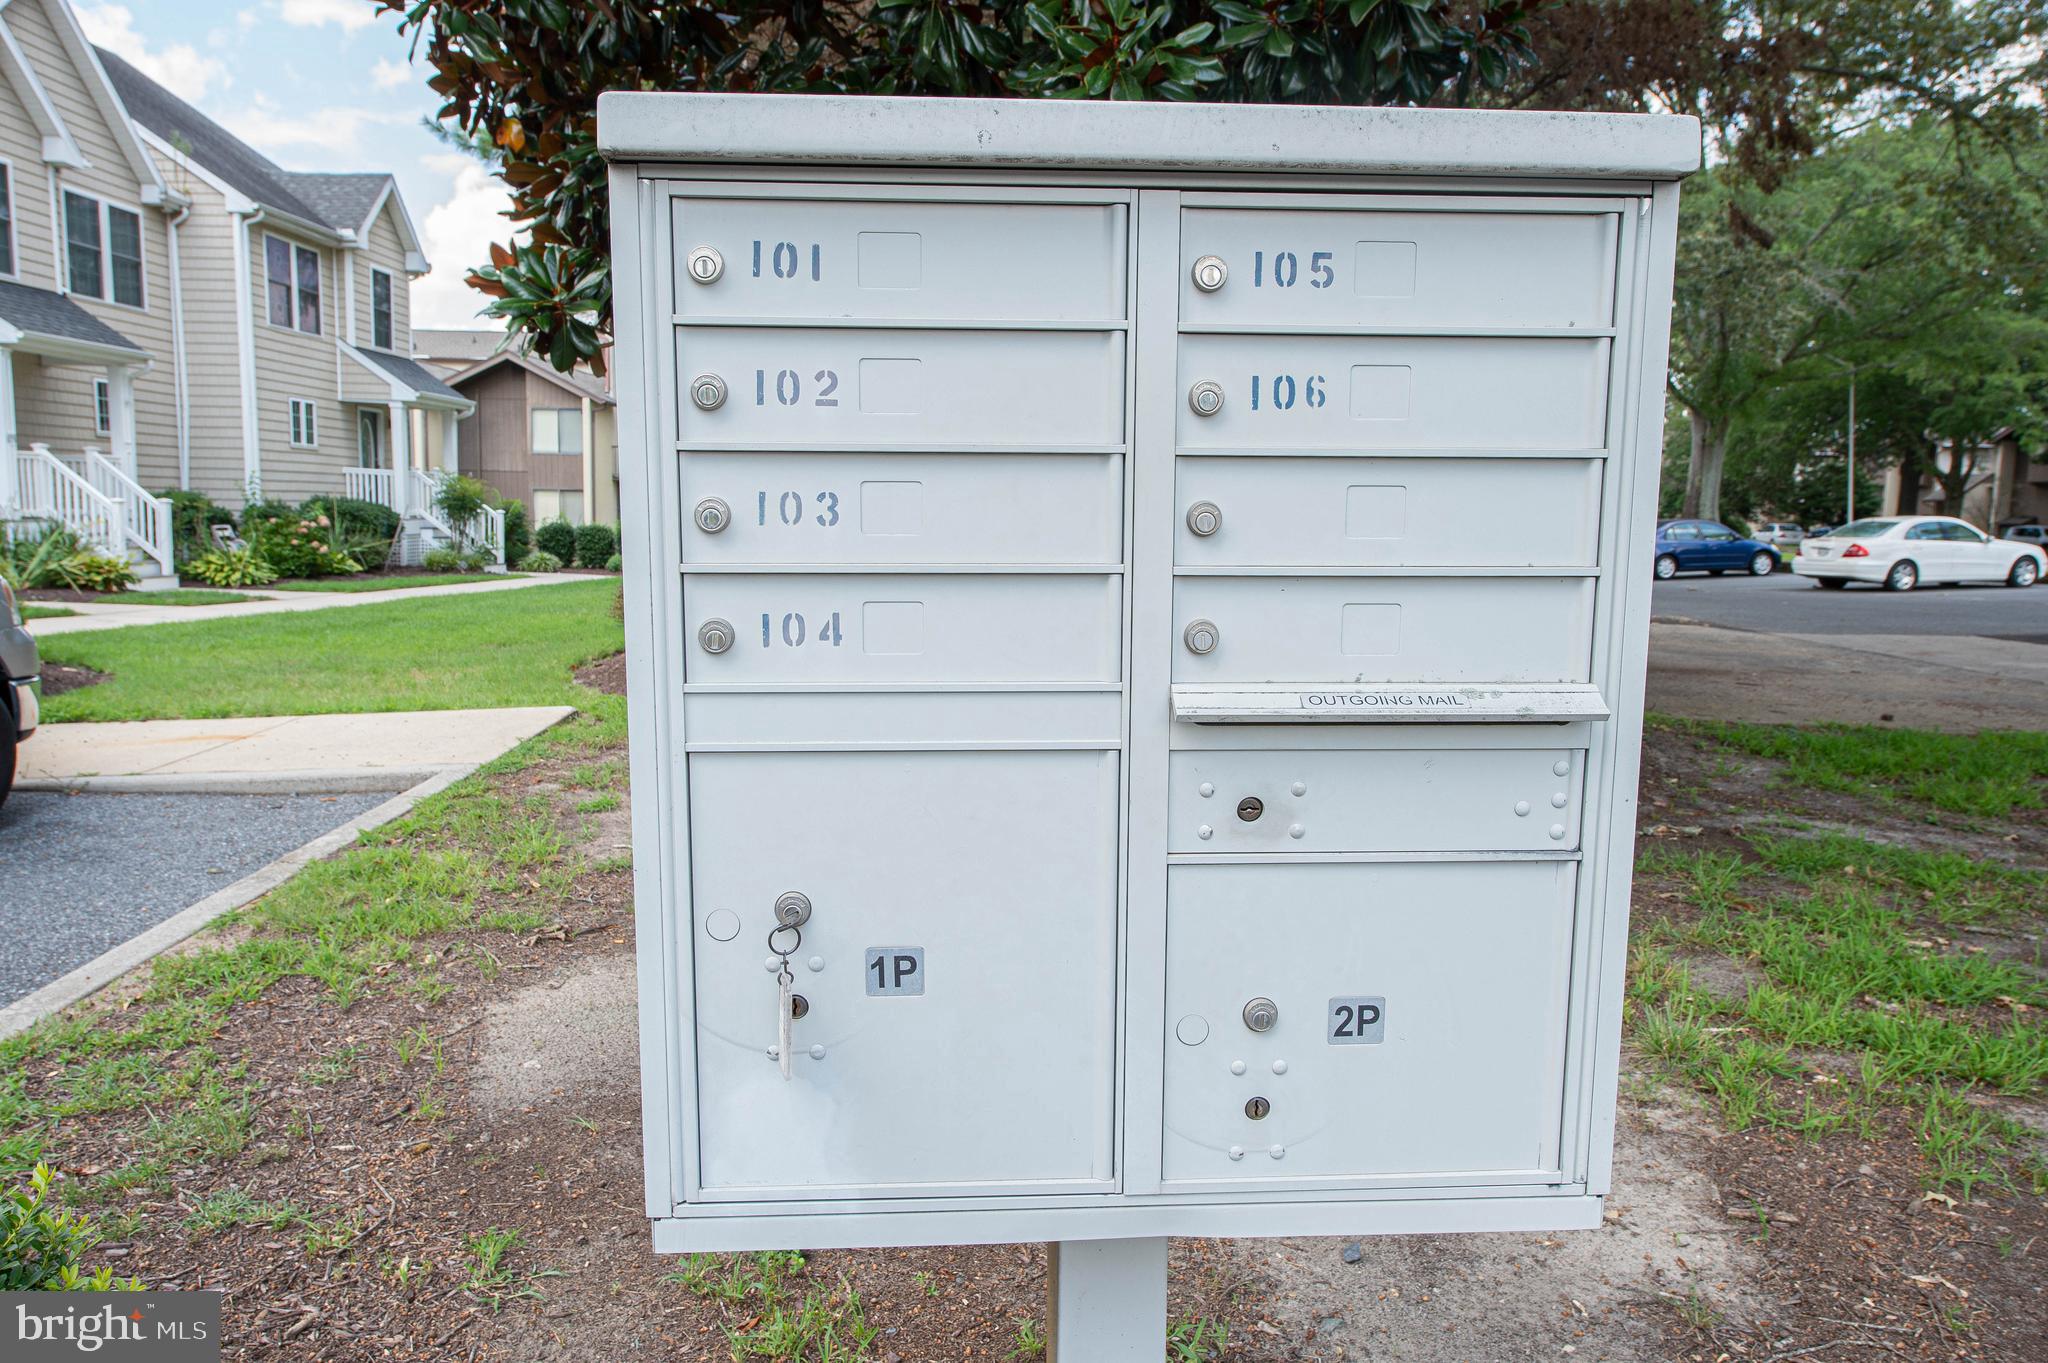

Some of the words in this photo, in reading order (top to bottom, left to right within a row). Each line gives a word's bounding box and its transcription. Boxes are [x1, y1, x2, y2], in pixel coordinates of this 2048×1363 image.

[752, 240, 821, 282] 101
[1254, 251, 1335, 289] 105
[756, 369, 839, 407] 102
[1251, 375, 1326, 410] 106
[758, 491, 840, 527] 103
[762, 612, 843, 648] 104
[1308, 694, 1413, 706] OUTGOING
[1418, 694, 1464, 706] MAIL
[870, 955, 918, 989] 1P
[1333, 1004, 1381, 1038] 2P
